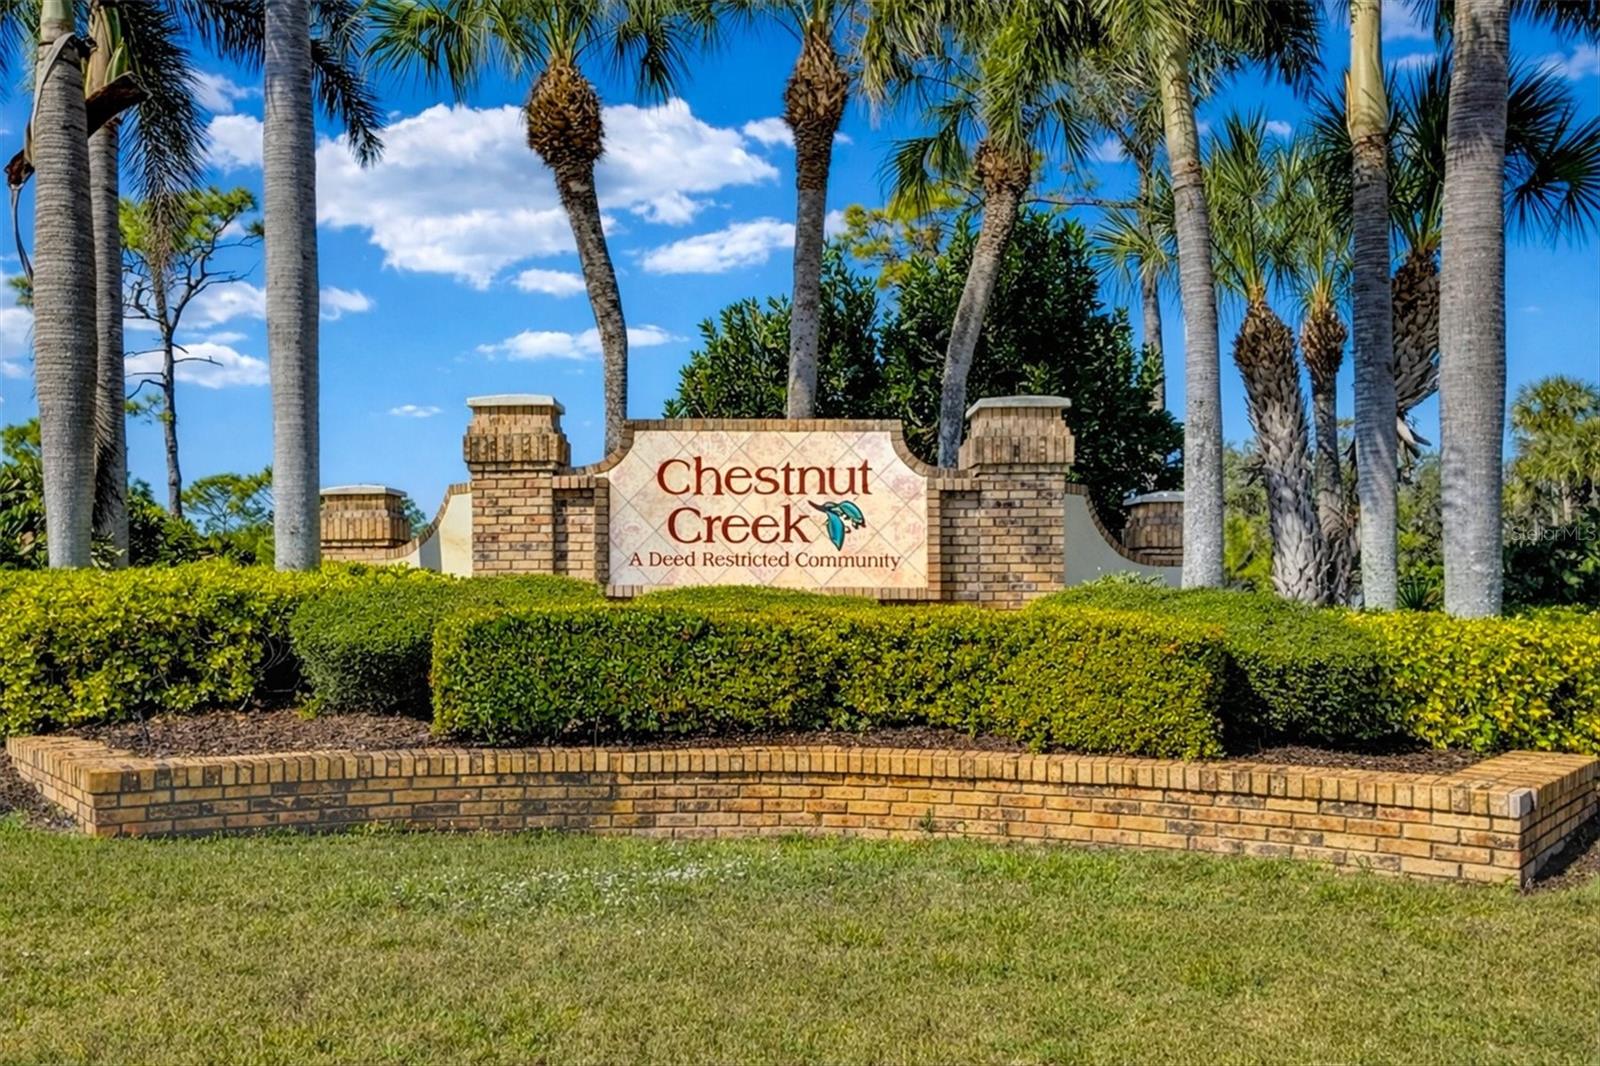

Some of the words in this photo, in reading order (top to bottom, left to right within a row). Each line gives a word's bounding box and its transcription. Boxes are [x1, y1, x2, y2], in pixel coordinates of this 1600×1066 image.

[656, 456, 873, 496] Chestnut
[667, 504, 813, 545] Creek
[629, 552, 643, 567] A
[649, 551, 696, 567] Deed
[702, 551, 790, 568] Restricted
[795, 551, 901, 571] Community
